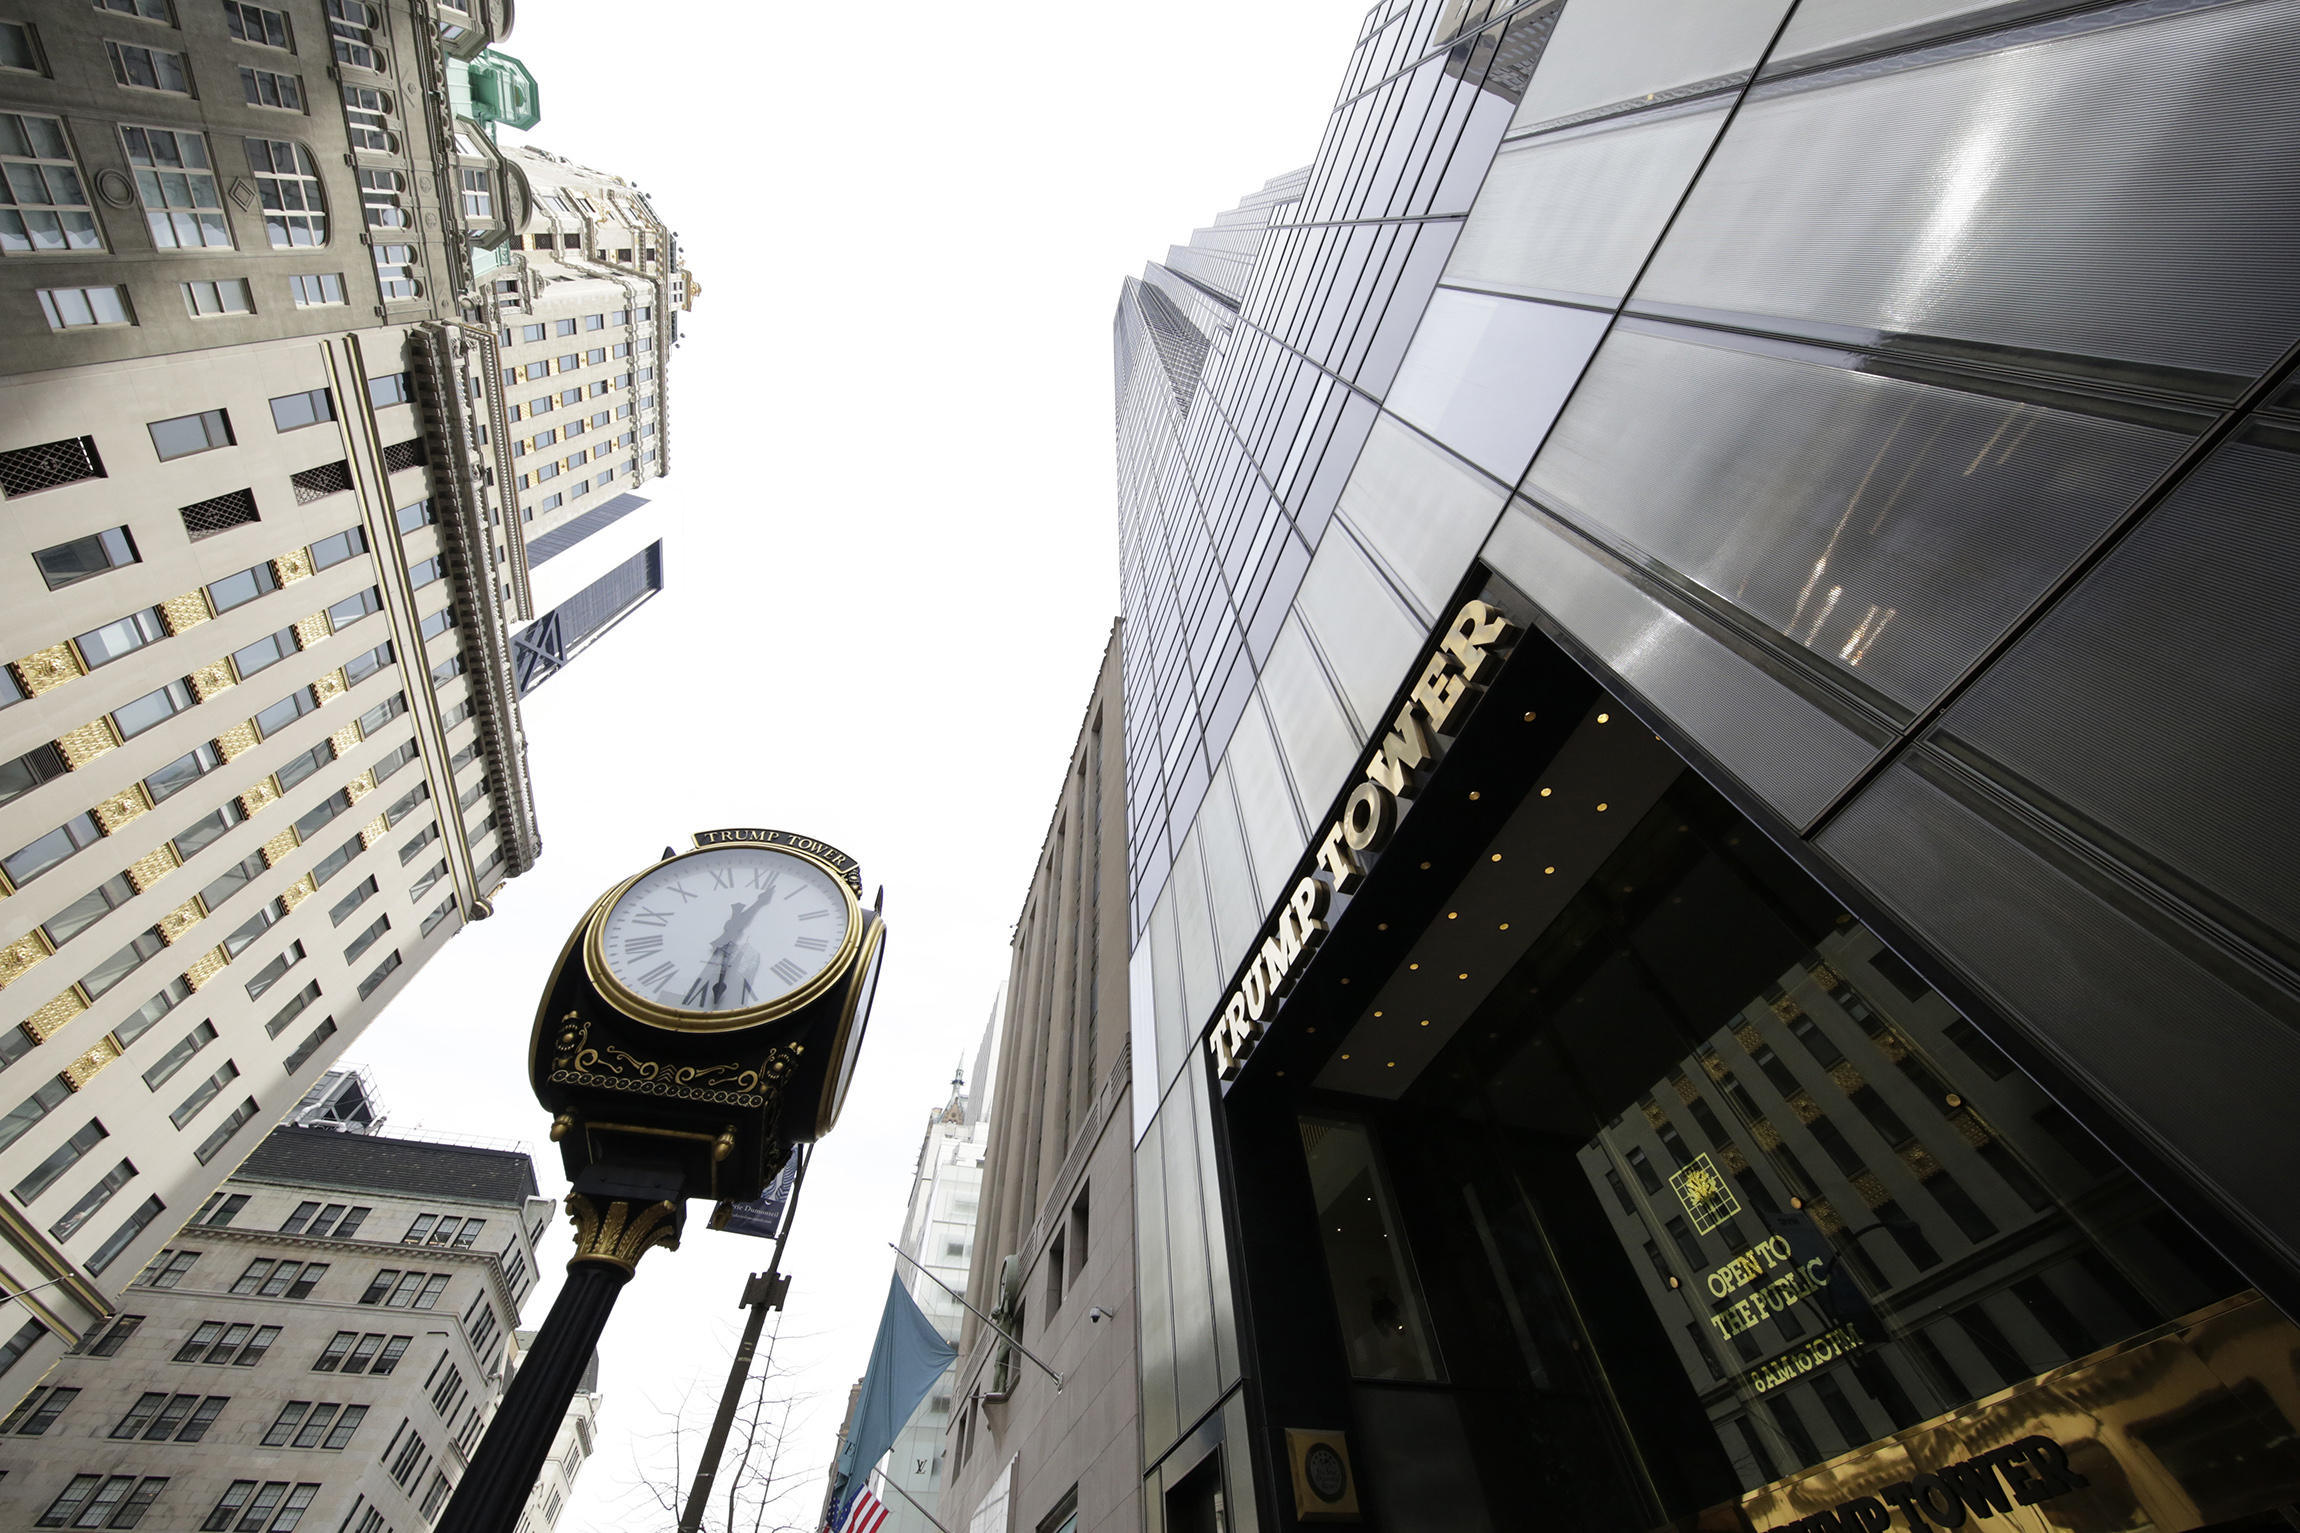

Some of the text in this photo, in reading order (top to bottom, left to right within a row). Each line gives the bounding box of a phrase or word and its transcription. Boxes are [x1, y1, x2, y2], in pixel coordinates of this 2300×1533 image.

[704, 829, 846, 866] TRUMP TOWER
[1209, 599, 1516, 1081] TRUMP TOWER
[744, 1205, 780, 1218] Dumonteil
[1707, 1234, 1791, 1298] OPEN TO
[1711, 1257, 1831, 1341] THE PUBLIC
[1791, 1353, 1813, 1373] to
[1878, 1435, 2091, 1533] TOWER
